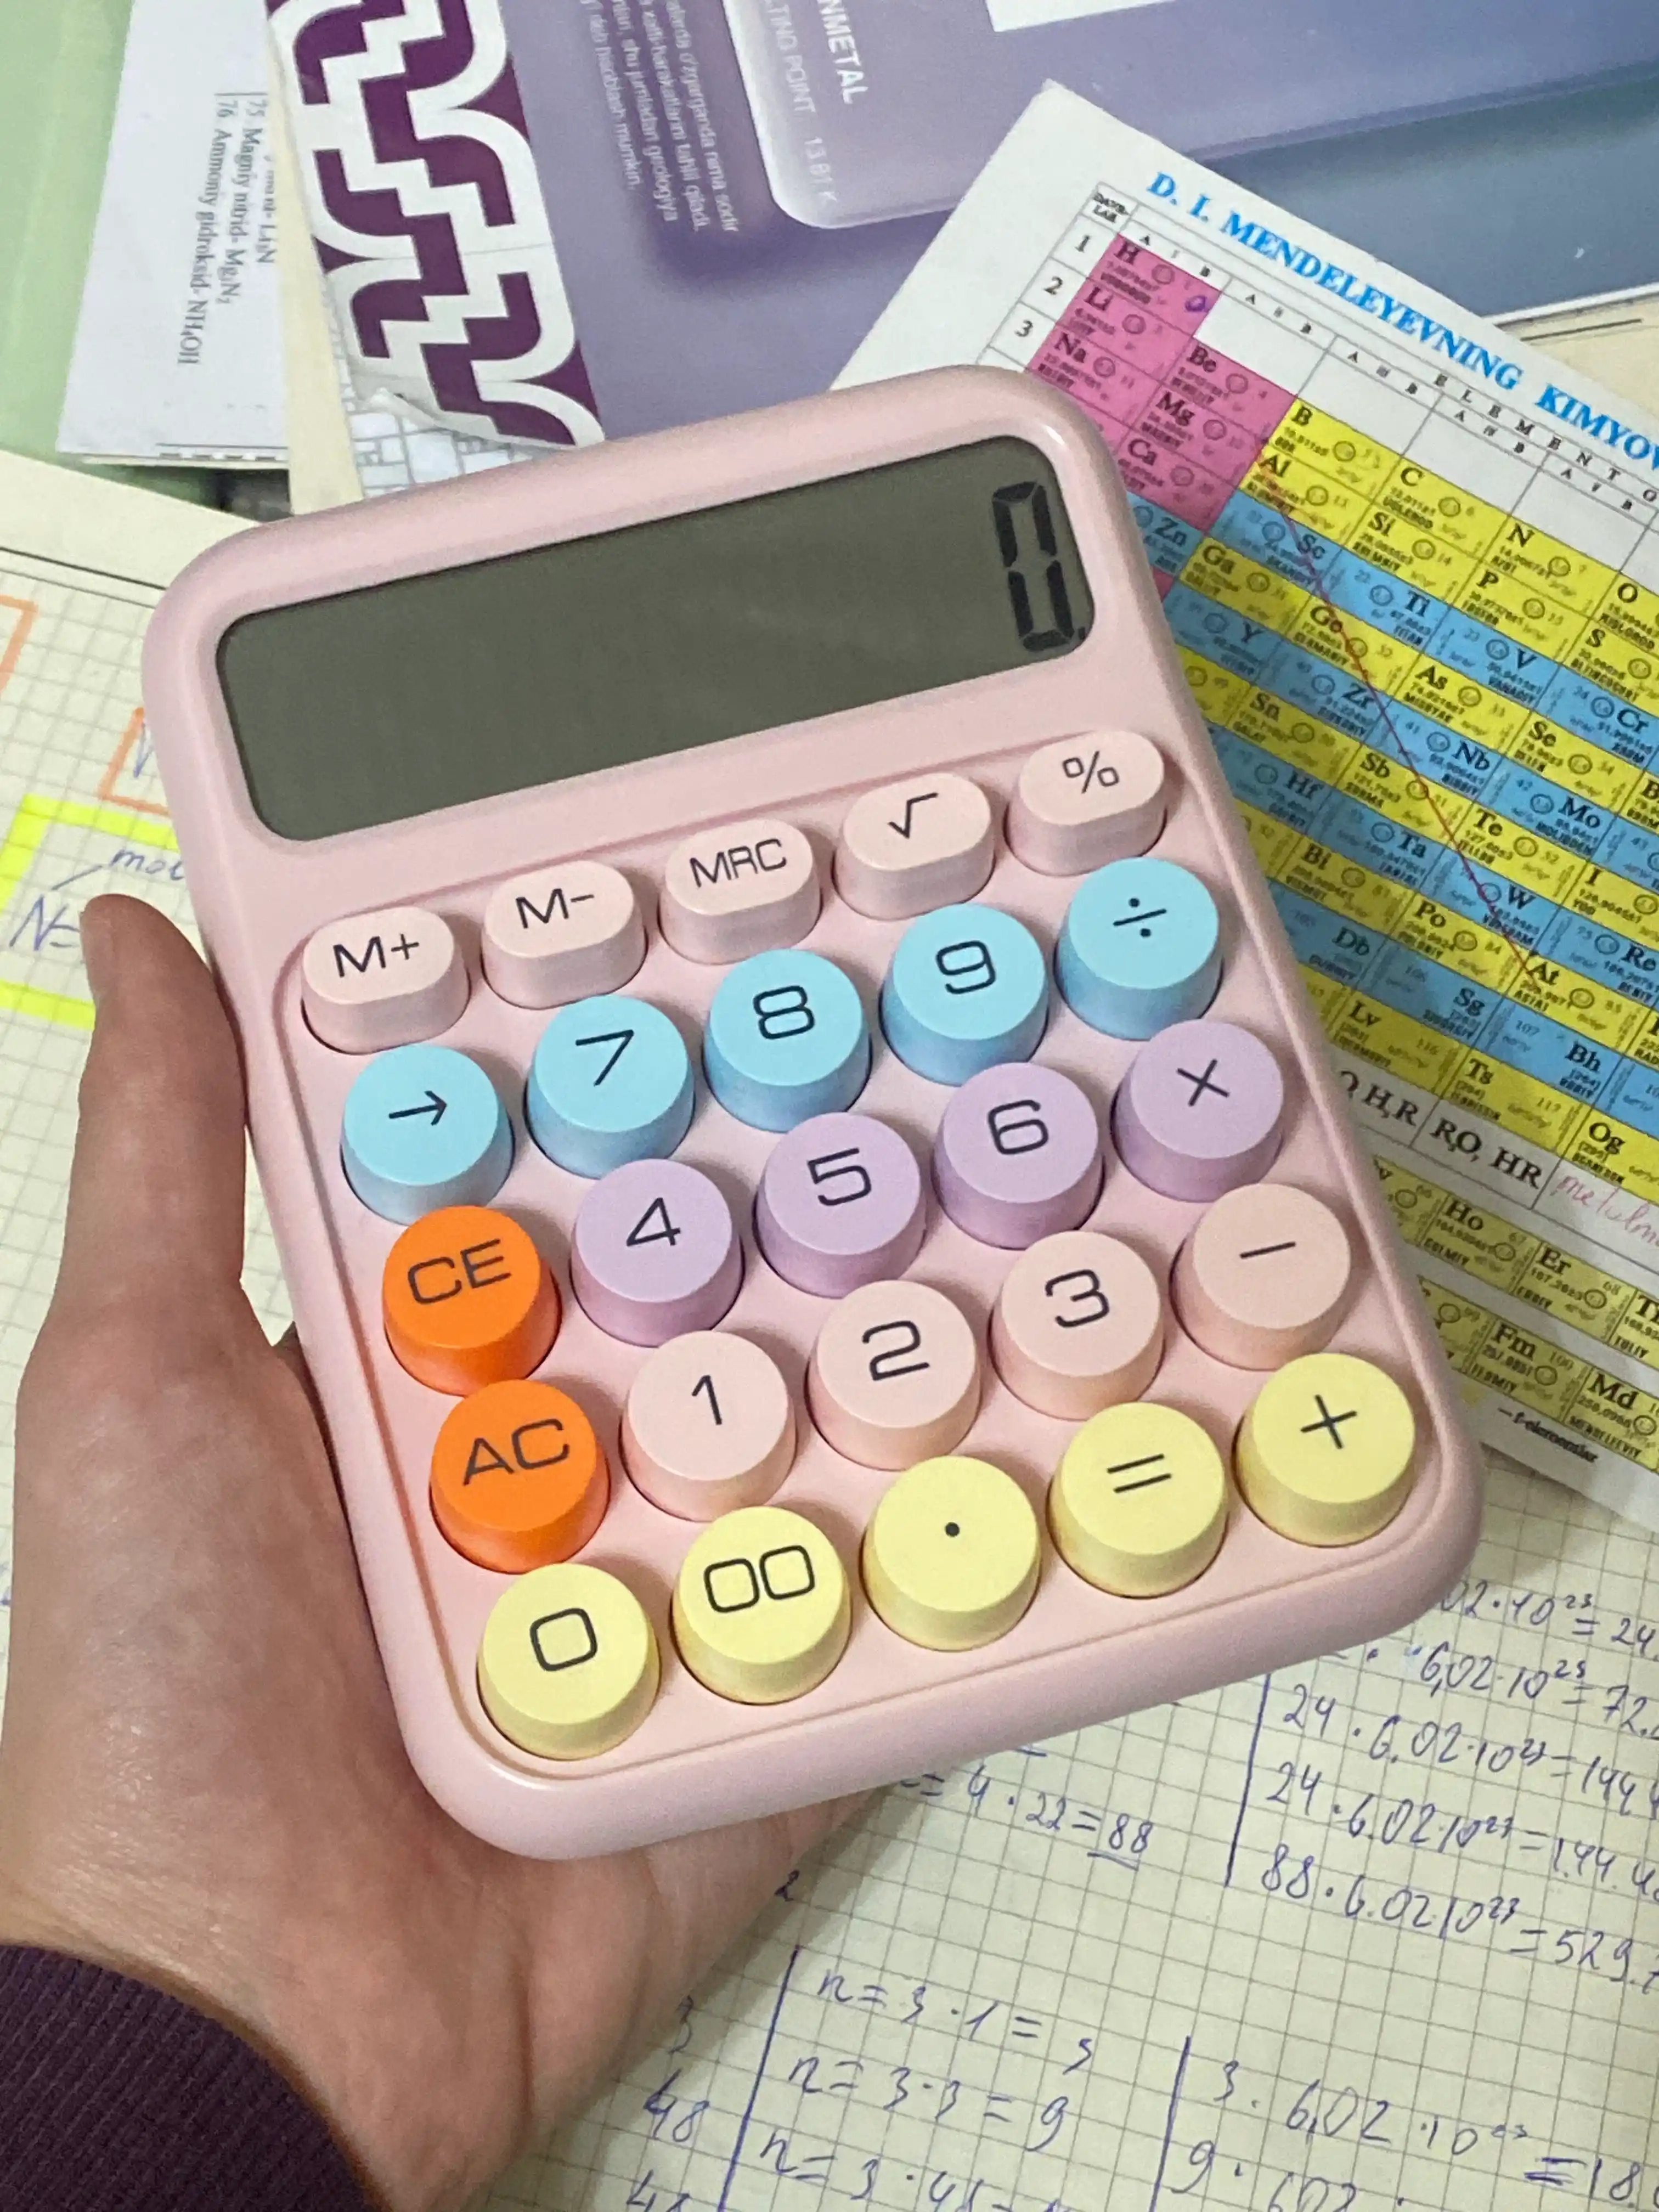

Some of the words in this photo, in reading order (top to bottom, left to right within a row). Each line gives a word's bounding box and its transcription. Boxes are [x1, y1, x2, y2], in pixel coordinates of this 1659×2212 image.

[1074, 234, 1090, 253] 1
[1116, 240, 1141, 267] H
[1043, 276, 1063, 295] 2
[1147, 171, 1178, 206] D.
[1187, 194, 1214, 223] I.
[1219, 210, 1525, 391] MENDELEYEVNING
[1014, 319, 1034, 337] 3
[1053, 332, 1087, 365] Na
[1187, 343, 1218, 374] Be
[1155, 390, 1196, 427] Mg
[1290, 405, 1314, 426] B
[1127, 439, 1158, 466] Ca
[1260, 454, 1290, 479] Al
[1400, 466, 1425, 487] C
[1153, 516, 1187, 547] Zn
[1505, 522, 1536, 548] N
[1202, 544, 1235, 575] Ga
[1476, 569, 1499, 589] P
[1617, 582, 1639, 604] O
[1241, 623, 1262, 643] Y
[1586, 628, 1606, 648] S
[1516, 648, 1539, 670] V
[1414, 664, 1449, 691] As
[1249, 692, 1282, 723] Sn
[1617, 707, 1650, 734] Cr
[1528, 720, 1558, 748] Se
[1359, 751, 1391, 779] Sb
[1452, 738, 1491, 771] Nb
[1062, 750, 1120, 794] %
[1473, 811, 1504, 837] Te
[1557, 795, 1601, 830] Mo
[1397, 831, 1426, 859] Ta
[688, 838, 788, 889] MRC
[1508, 883, 1537, 910] W
[1414, 899, 1447, 928] Po
[331, 933, 421, 978] M+
[1331, 926, 1371, 956] Db
[934, 938, 997, 995] 9
[1621, 943, 1657, 972] Re
[1525, 961, 1560, 986] At
[752, 984, 816, 1042] 8
[1348, 999, 1382, 1028] Lv
[1452, 987, 1486, 1018] Sg
[574, 1029, 636, 1088] 7
[1564, 1041, 1602, 1074] Bh
[986, 1098, 1050, 1156] 6
[1588, 1121, 1626, 1155] Og
[807, 1147, 872, 1207] 5
[1488, 1146, 1542, 1190] HR
[625, 1196, 682, 1249] 4
[1445, 1200, 1484, 1231] Ho
[407, 1238, 512, 1306] CE
[1536, 1246, 1572, 1276] Er
[1044, 1268, 1110, 1329] 3
[861, 1319, 931, 1381] 2
[1491, 1322, 1537, 1362] Fm
[691, 1374, 724, 1426] 1
[1587, 1373, 1639, 1410] Md
[461, 1417, 571, 1487] AC
[703, 1543, 816, 1614] 00
[528, 1606, 599, 1673] 0
